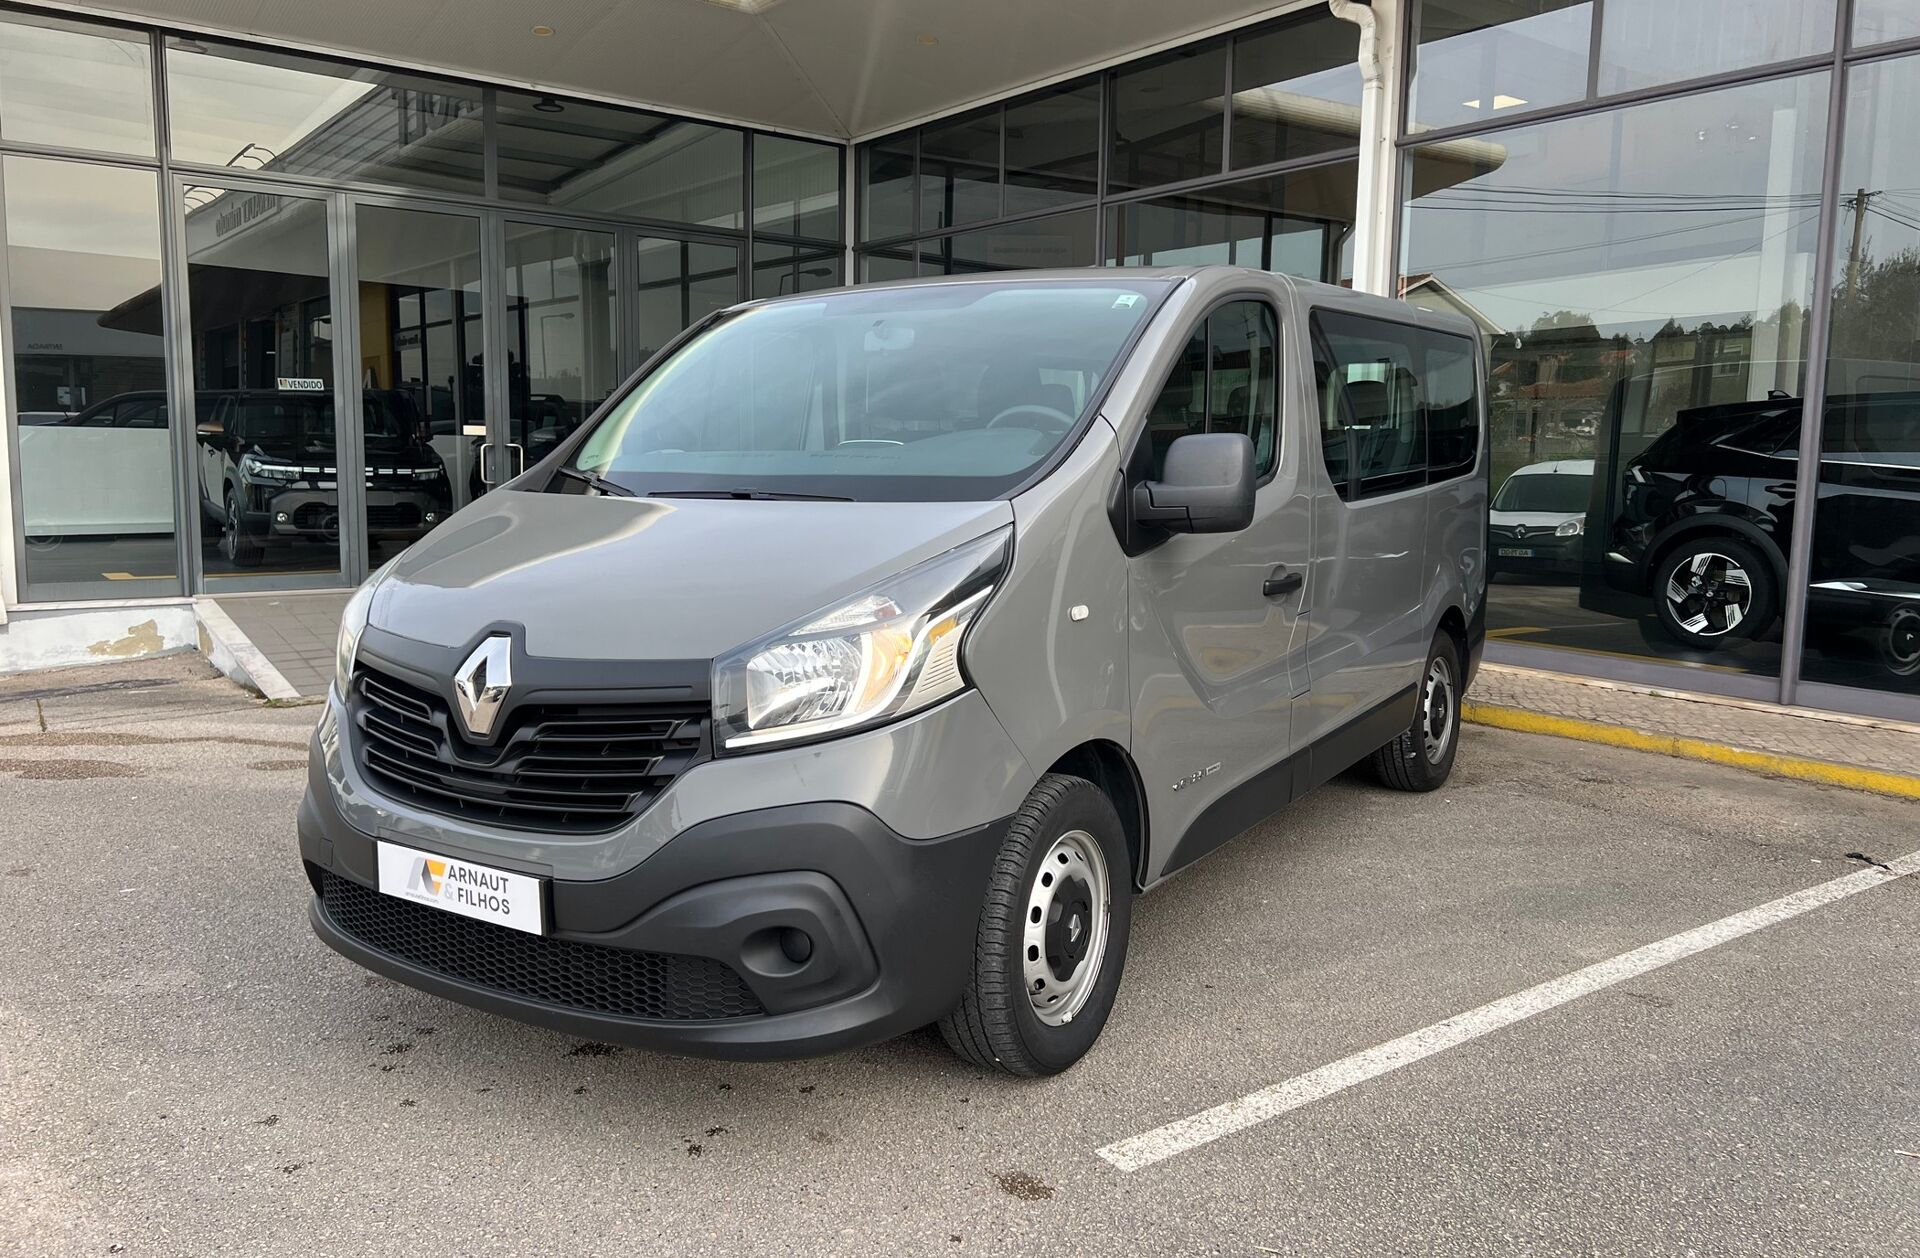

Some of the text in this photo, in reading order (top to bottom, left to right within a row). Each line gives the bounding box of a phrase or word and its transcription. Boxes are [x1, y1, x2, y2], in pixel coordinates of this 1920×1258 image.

[288, 380, 323, 389] VENDIDO
[448, 865, 509, 893] ARNAUT
[444, 883, 454, 901] &
[457, 888, 511, 915] FILHOS
